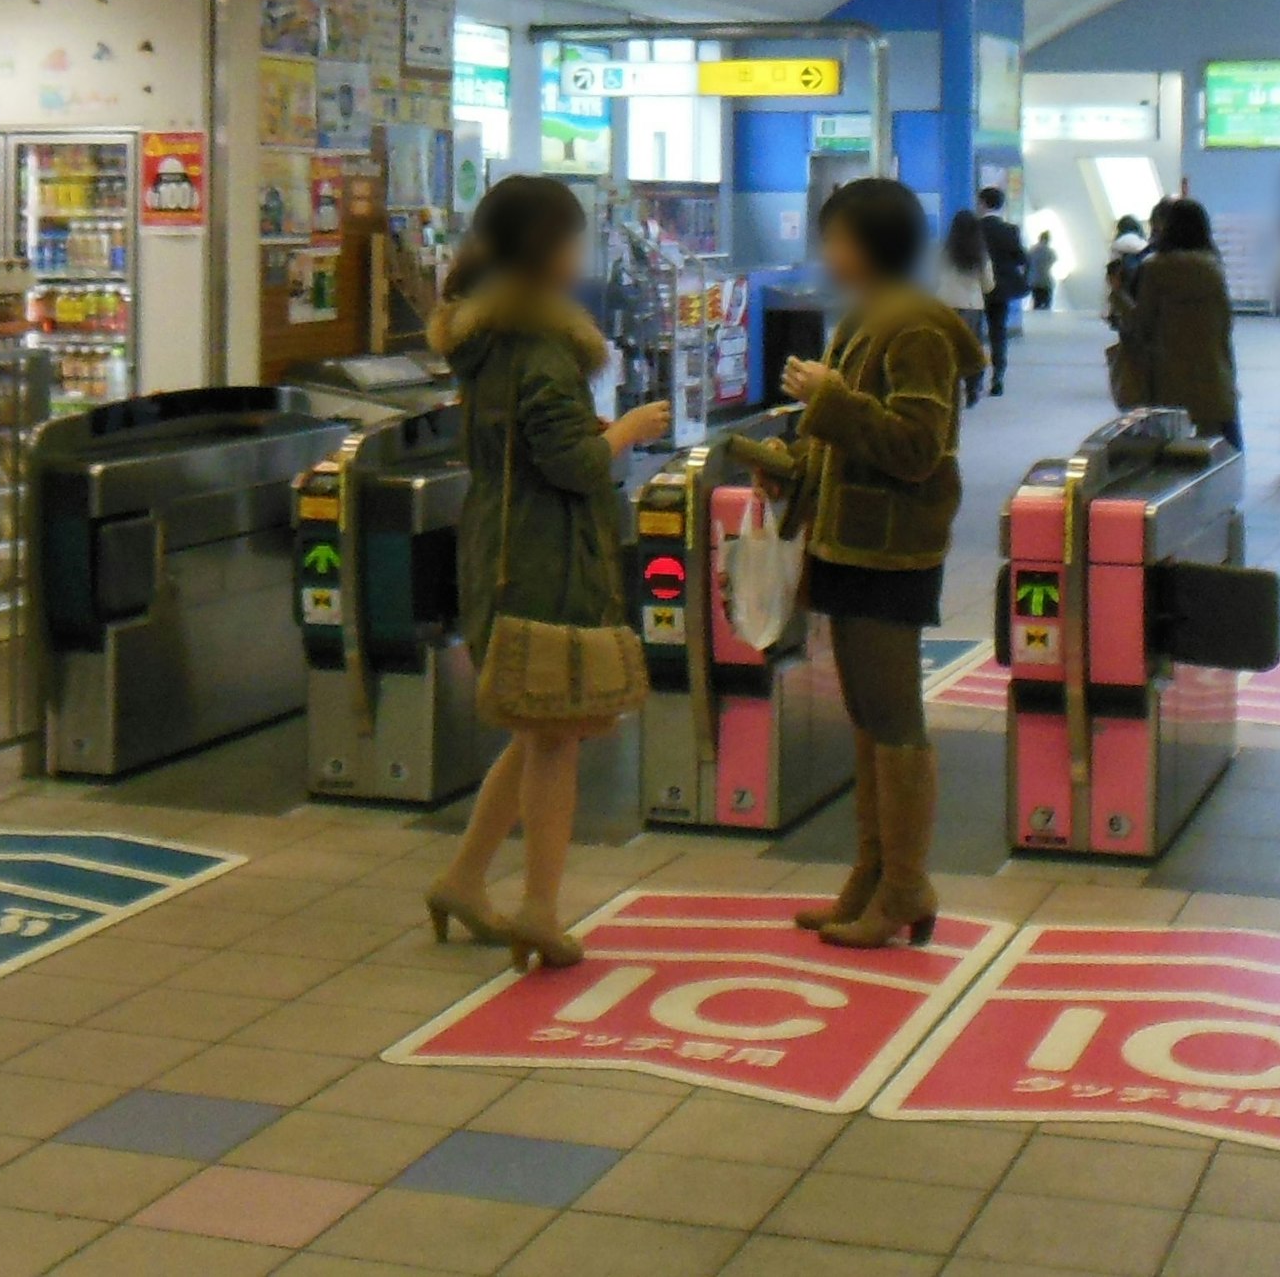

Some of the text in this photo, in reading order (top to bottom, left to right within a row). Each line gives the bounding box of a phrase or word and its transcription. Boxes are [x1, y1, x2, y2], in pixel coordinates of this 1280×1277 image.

[554, 965, 850, 1042] IC
[528, 1025, 787, 1068] タッチ専用
